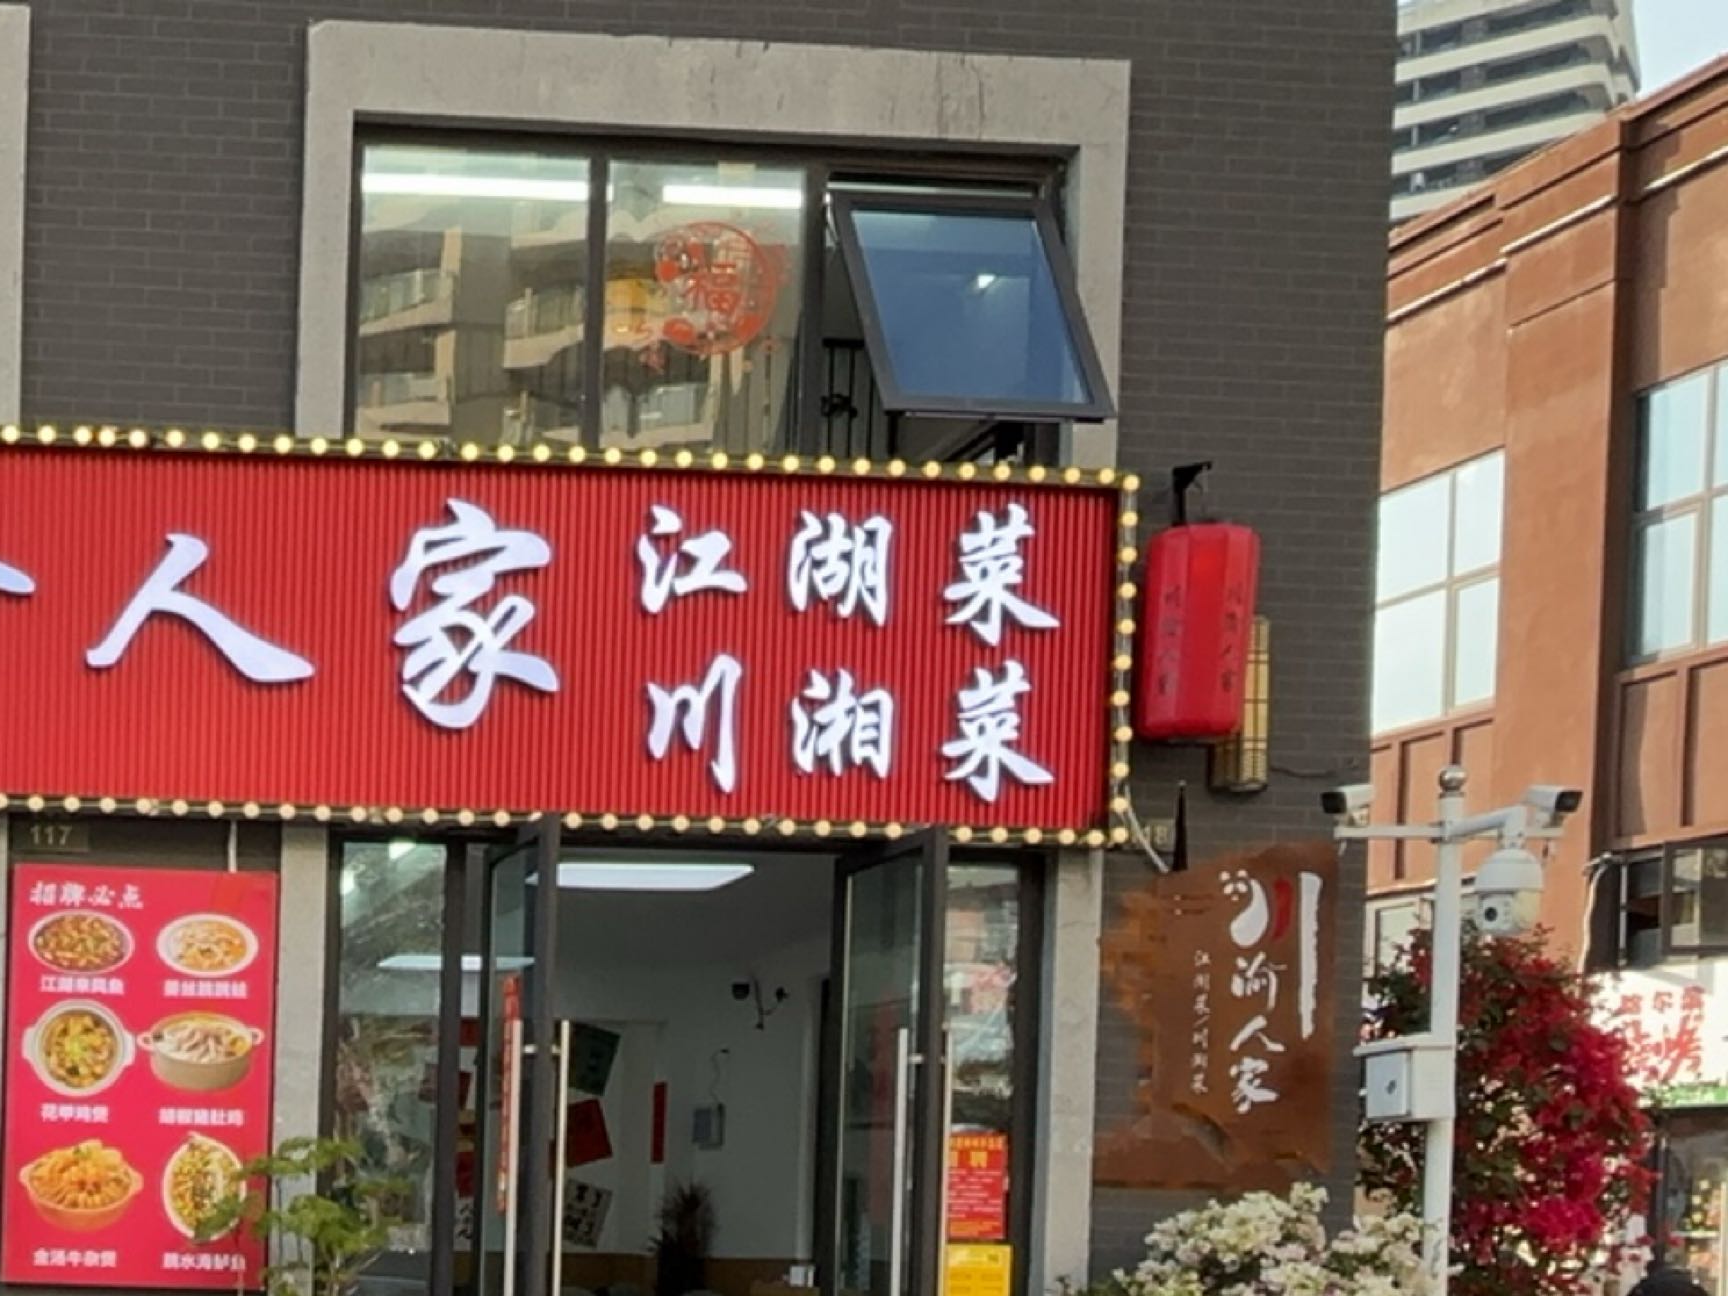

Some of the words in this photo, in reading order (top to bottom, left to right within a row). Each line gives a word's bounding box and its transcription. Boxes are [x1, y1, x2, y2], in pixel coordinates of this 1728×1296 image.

[637, 502, 1061, 646] 江湖菜
[645, 653, 1054, 802] 川湘菜
[30, 825, 71, 847] 117
[29, 881, 144, 909] 招牌必点
